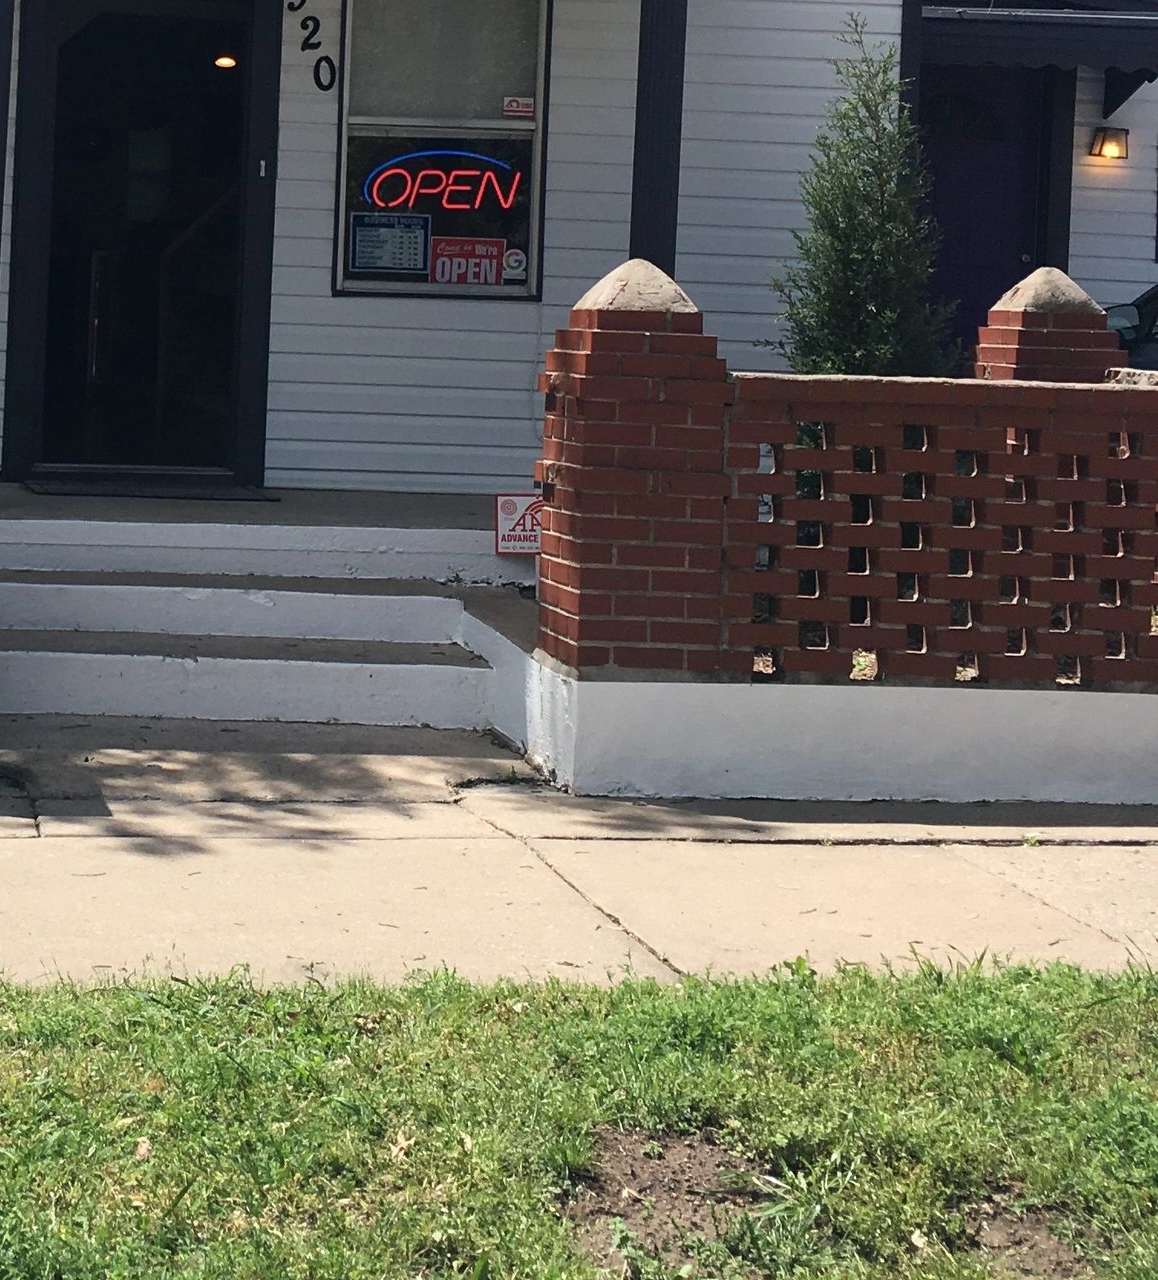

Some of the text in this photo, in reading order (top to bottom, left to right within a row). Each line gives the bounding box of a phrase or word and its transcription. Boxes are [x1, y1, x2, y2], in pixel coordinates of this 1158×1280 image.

[372, 168, 522, 209] OPEN
[435, 256, 498, 284] OPEN
[501, 534, 539, 543] ADVANCE
